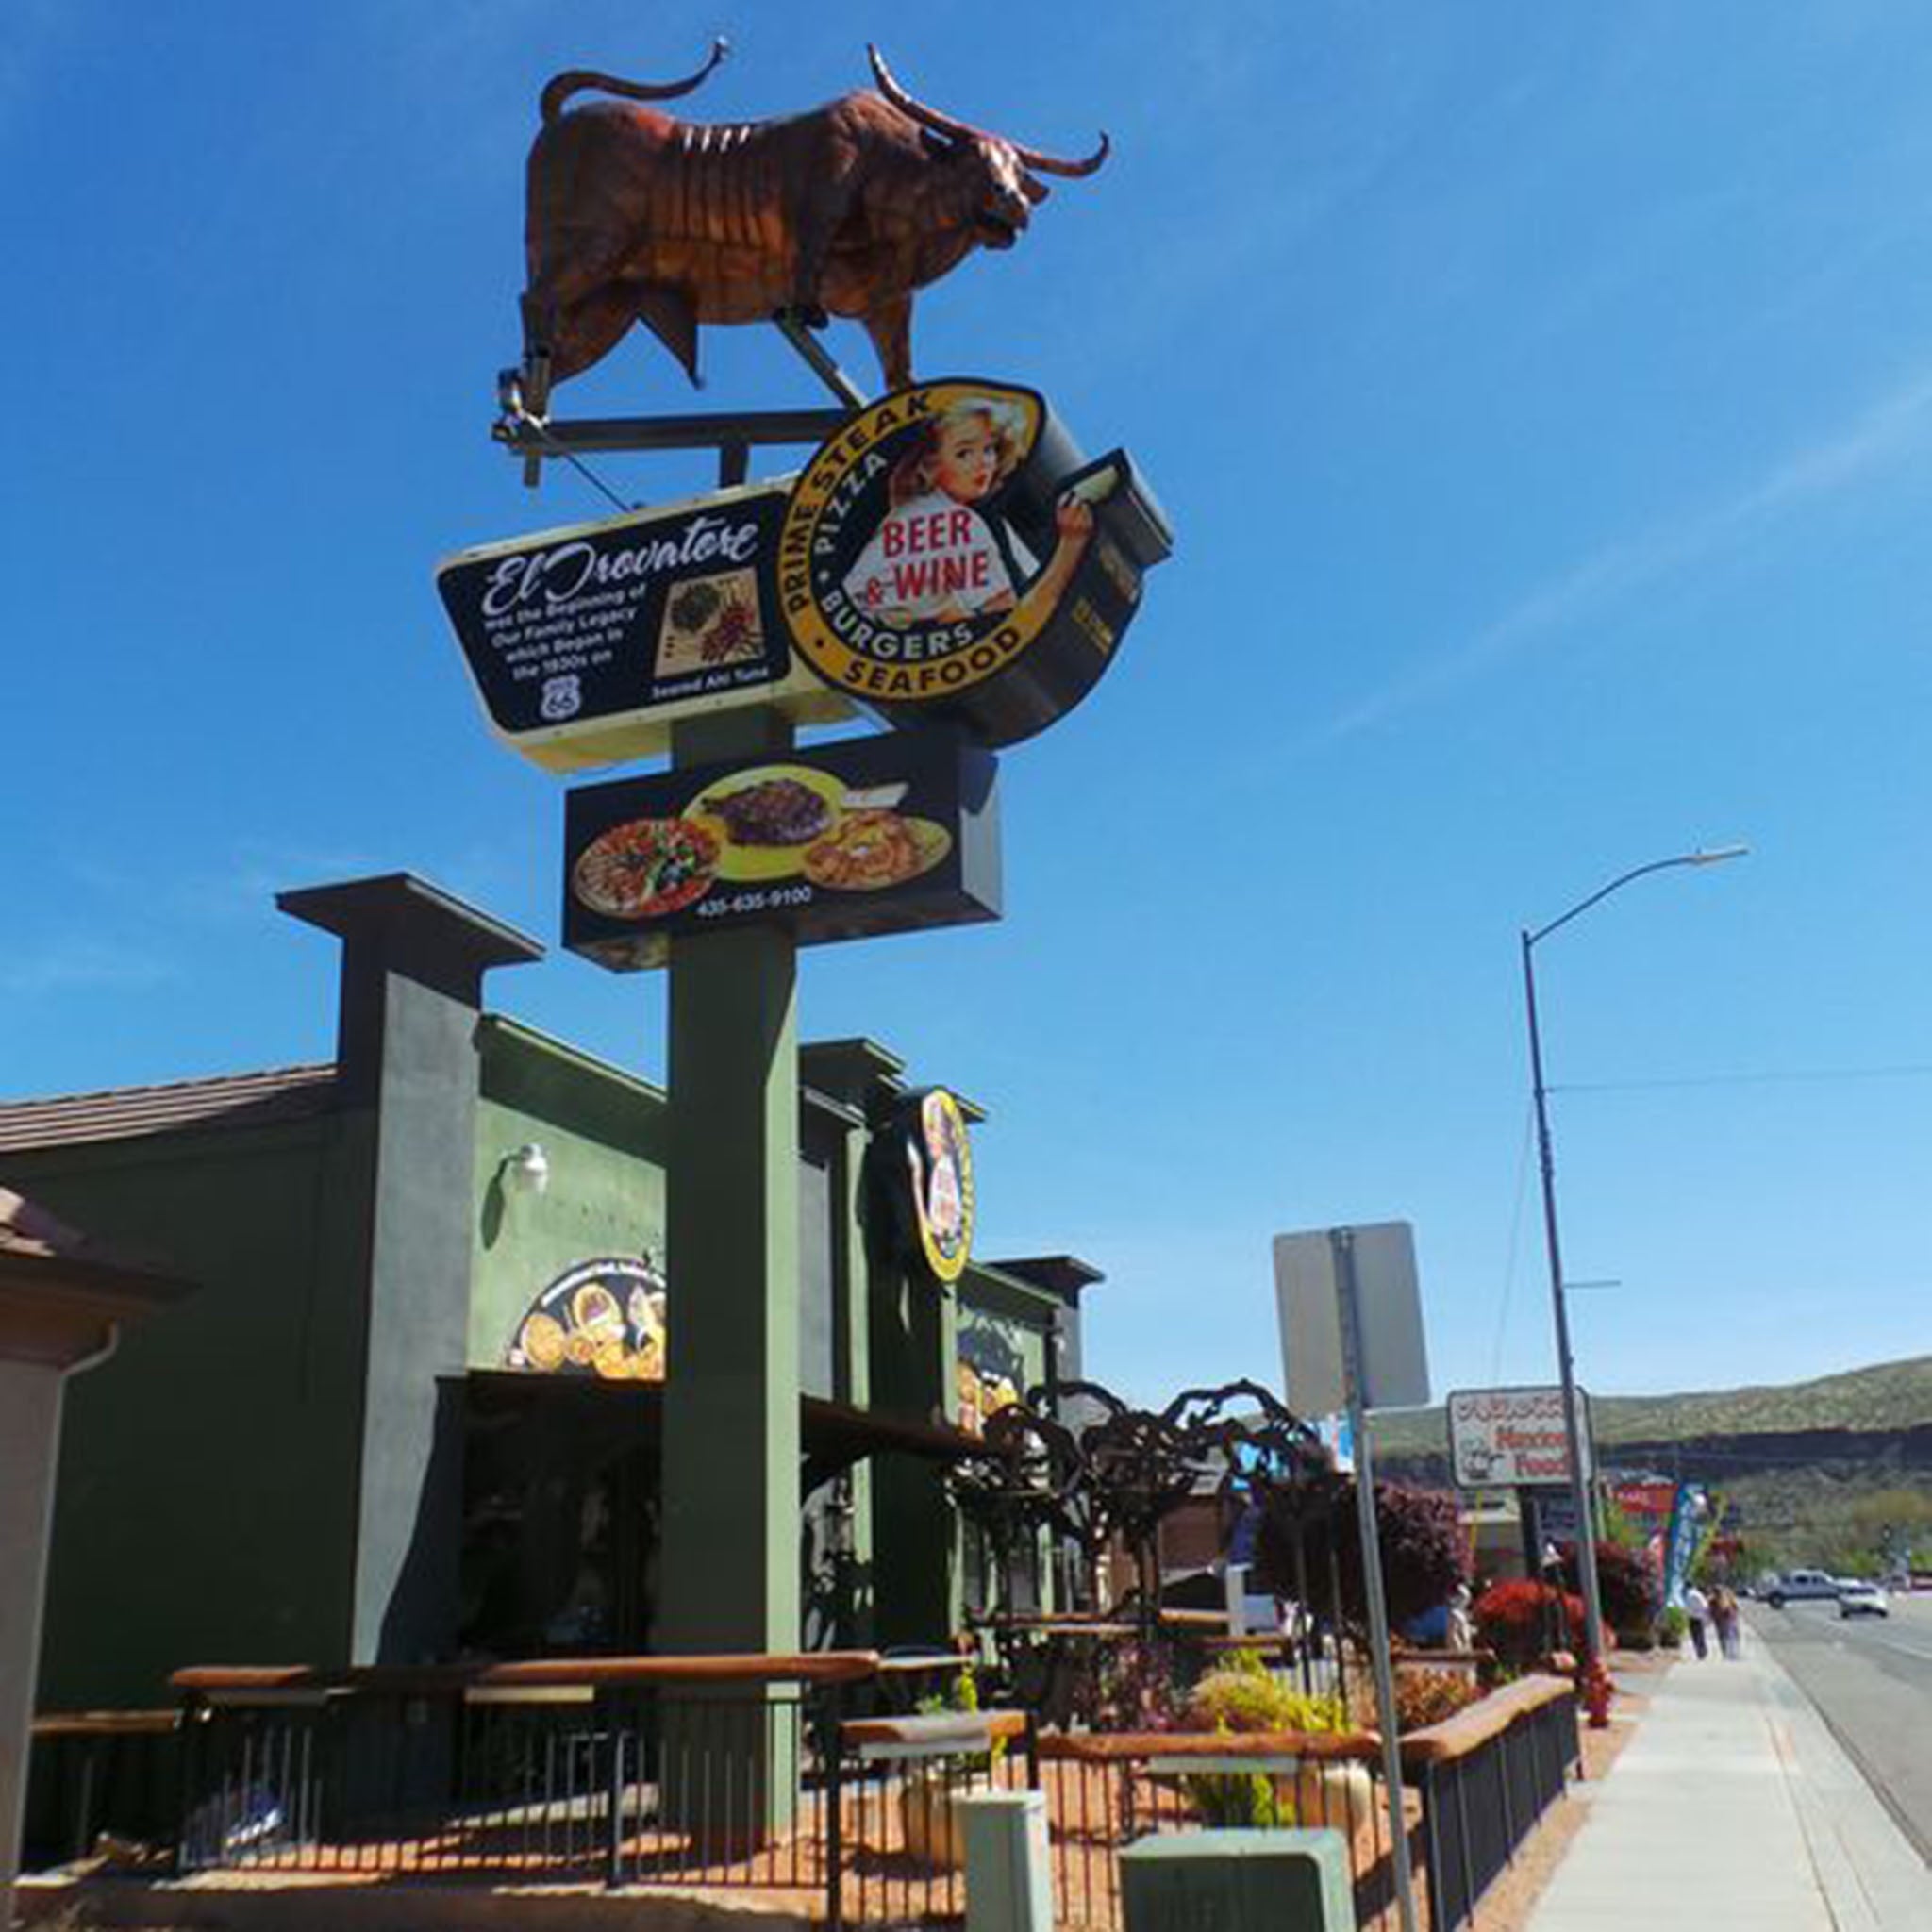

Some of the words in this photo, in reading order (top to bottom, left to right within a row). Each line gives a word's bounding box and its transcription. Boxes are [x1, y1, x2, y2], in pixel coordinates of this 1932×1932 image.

[784, 504, 819, 613] PRIME
[813, 391, 932, 491] STEAK
[815, 453, 887, 554] PIZZA
[882, 509, 972, 558] BEER
[481, 552, 546, 616] El
[546, 589, 625, 617] Beginning
[628, 582, 647, 600] of
[865, 578, 885, 608] &
[892, 551, 990, 602] WINE
[491, 630, 521, 648] Our
[525, 619, 575, 640] Family
[577, 607, 638, 629] Legacy
[506, 642, 549, 663] which
[553, 629, 604, 654] Began
[607, 626, 624, 641] in
[821, 589, 973, 659] BURGERS
[513, 662, 540, 680] the
[591, 649, 613, 664] on
[843, 625, 1021, 693] SEAFOOD
